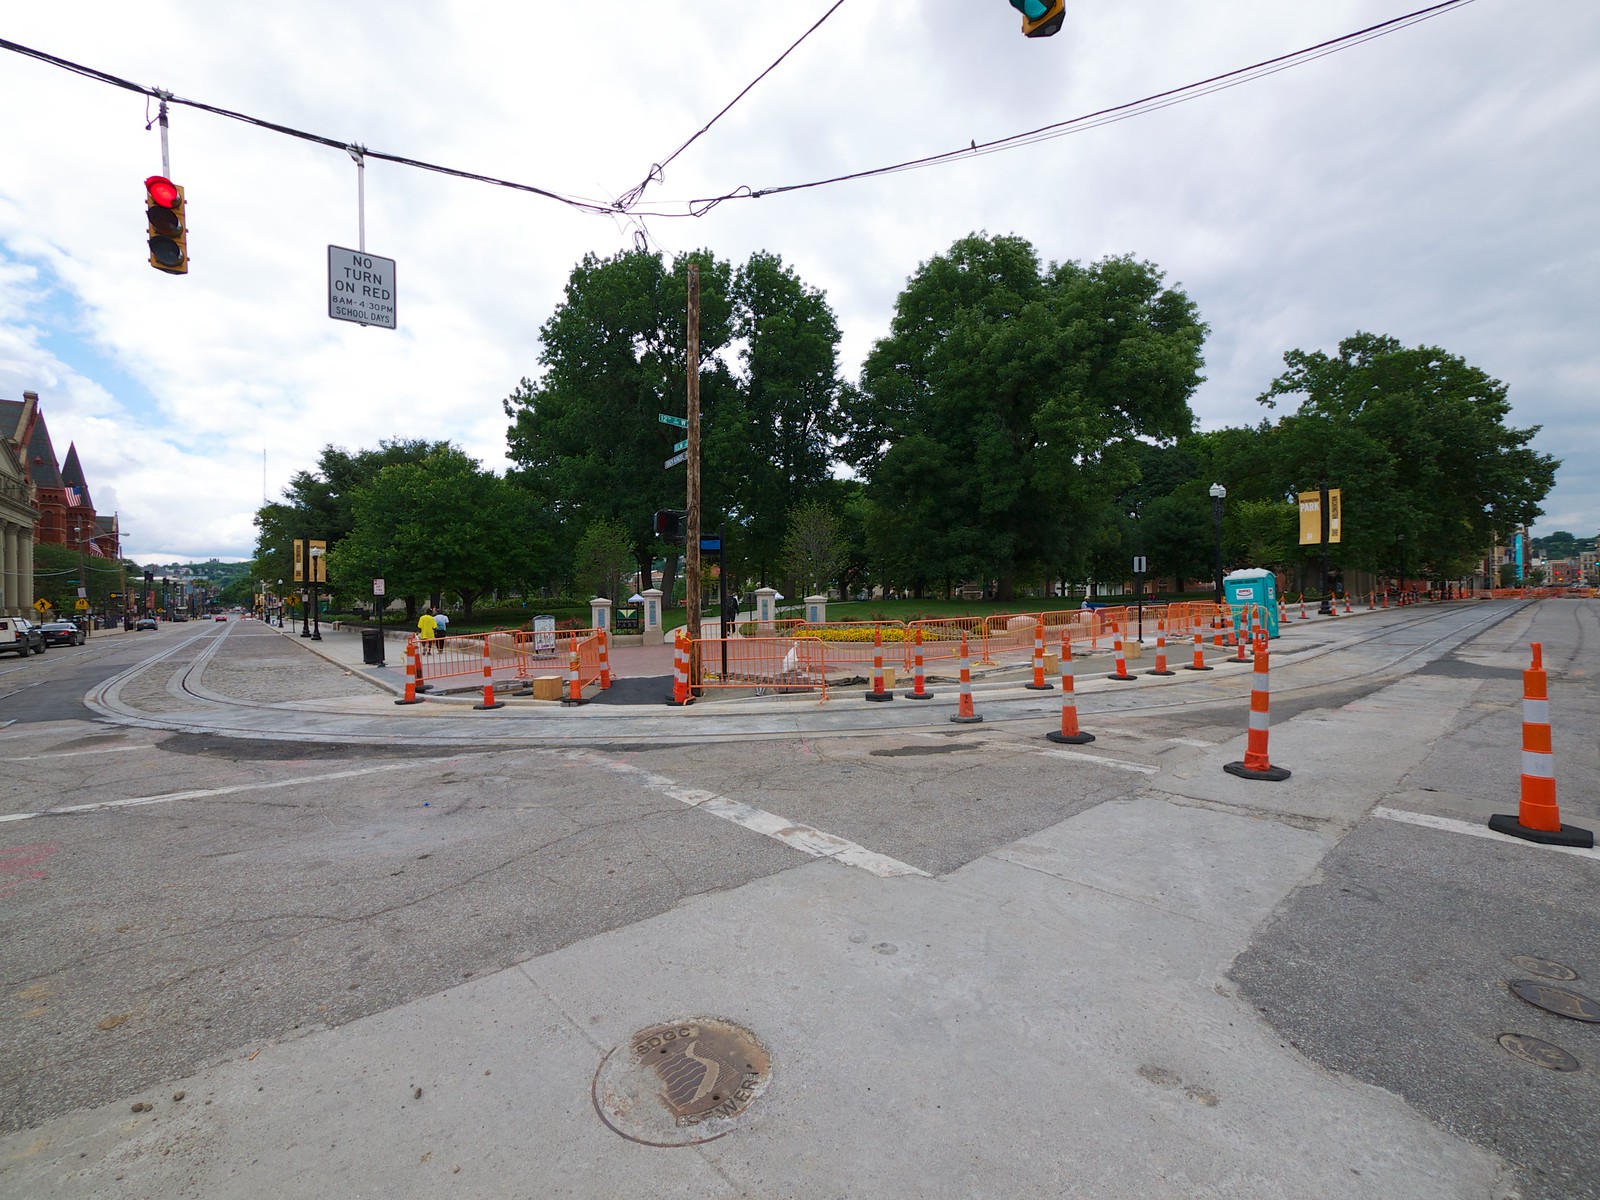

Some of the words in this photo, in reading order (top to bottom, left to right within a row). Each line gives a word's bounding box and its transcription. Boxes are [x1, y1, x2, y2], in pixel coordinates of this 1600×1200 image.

[353, 255, 373, 269] NO
[343, 266, 382, 286] TURN
[335, 279, 355, 294] ON
[362, 285, 390, 301] RED
[336, 306, 368, 320] SCHOOL
[370, 312, 390, 324] DAYS
[1300, 502, 1320, 512] PARK
